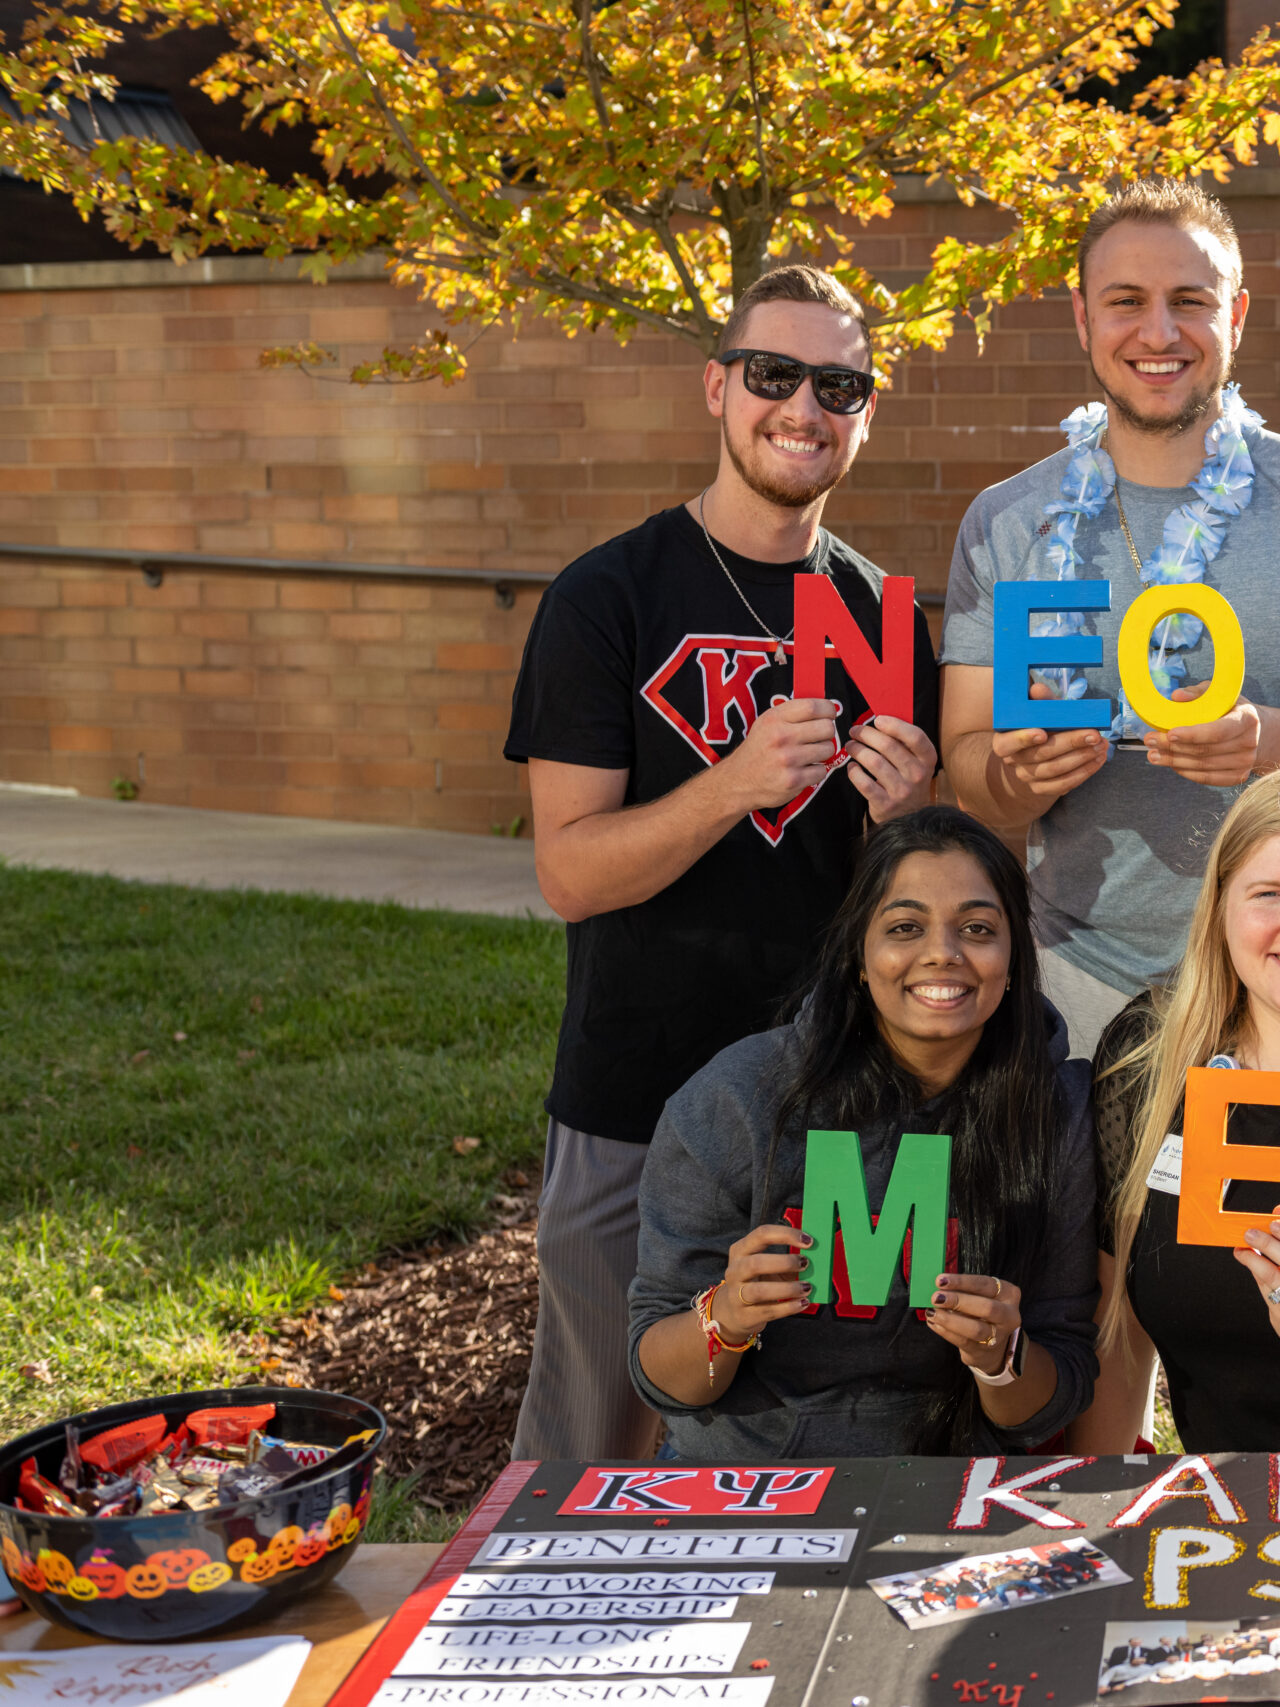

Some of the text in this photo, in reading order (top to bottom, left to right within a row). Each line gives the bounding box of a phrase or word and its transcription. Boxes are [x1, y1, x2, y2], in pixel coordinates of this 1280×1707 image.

[793, 573, 915, 724] N
[993, 579, 1112, 731] E
[1117, 582, 1246, 732] O
[1152, 1168, 1180, 1181] SHERIDAN
[800, 1129, 953, 1309] M
[498, 1533, 838, 1559] BENEFITS
[477, 1576, 767, 1593] NETWORKING
[458, 1599, 728, 1618] LEADERSHIP
[438, 1628, 673, 1647] LIFE-LONG
[438, 1654, 727, 1672] FRIENDSHIPS
[400, 1682, 742, 1703] PROFESSIONAL
